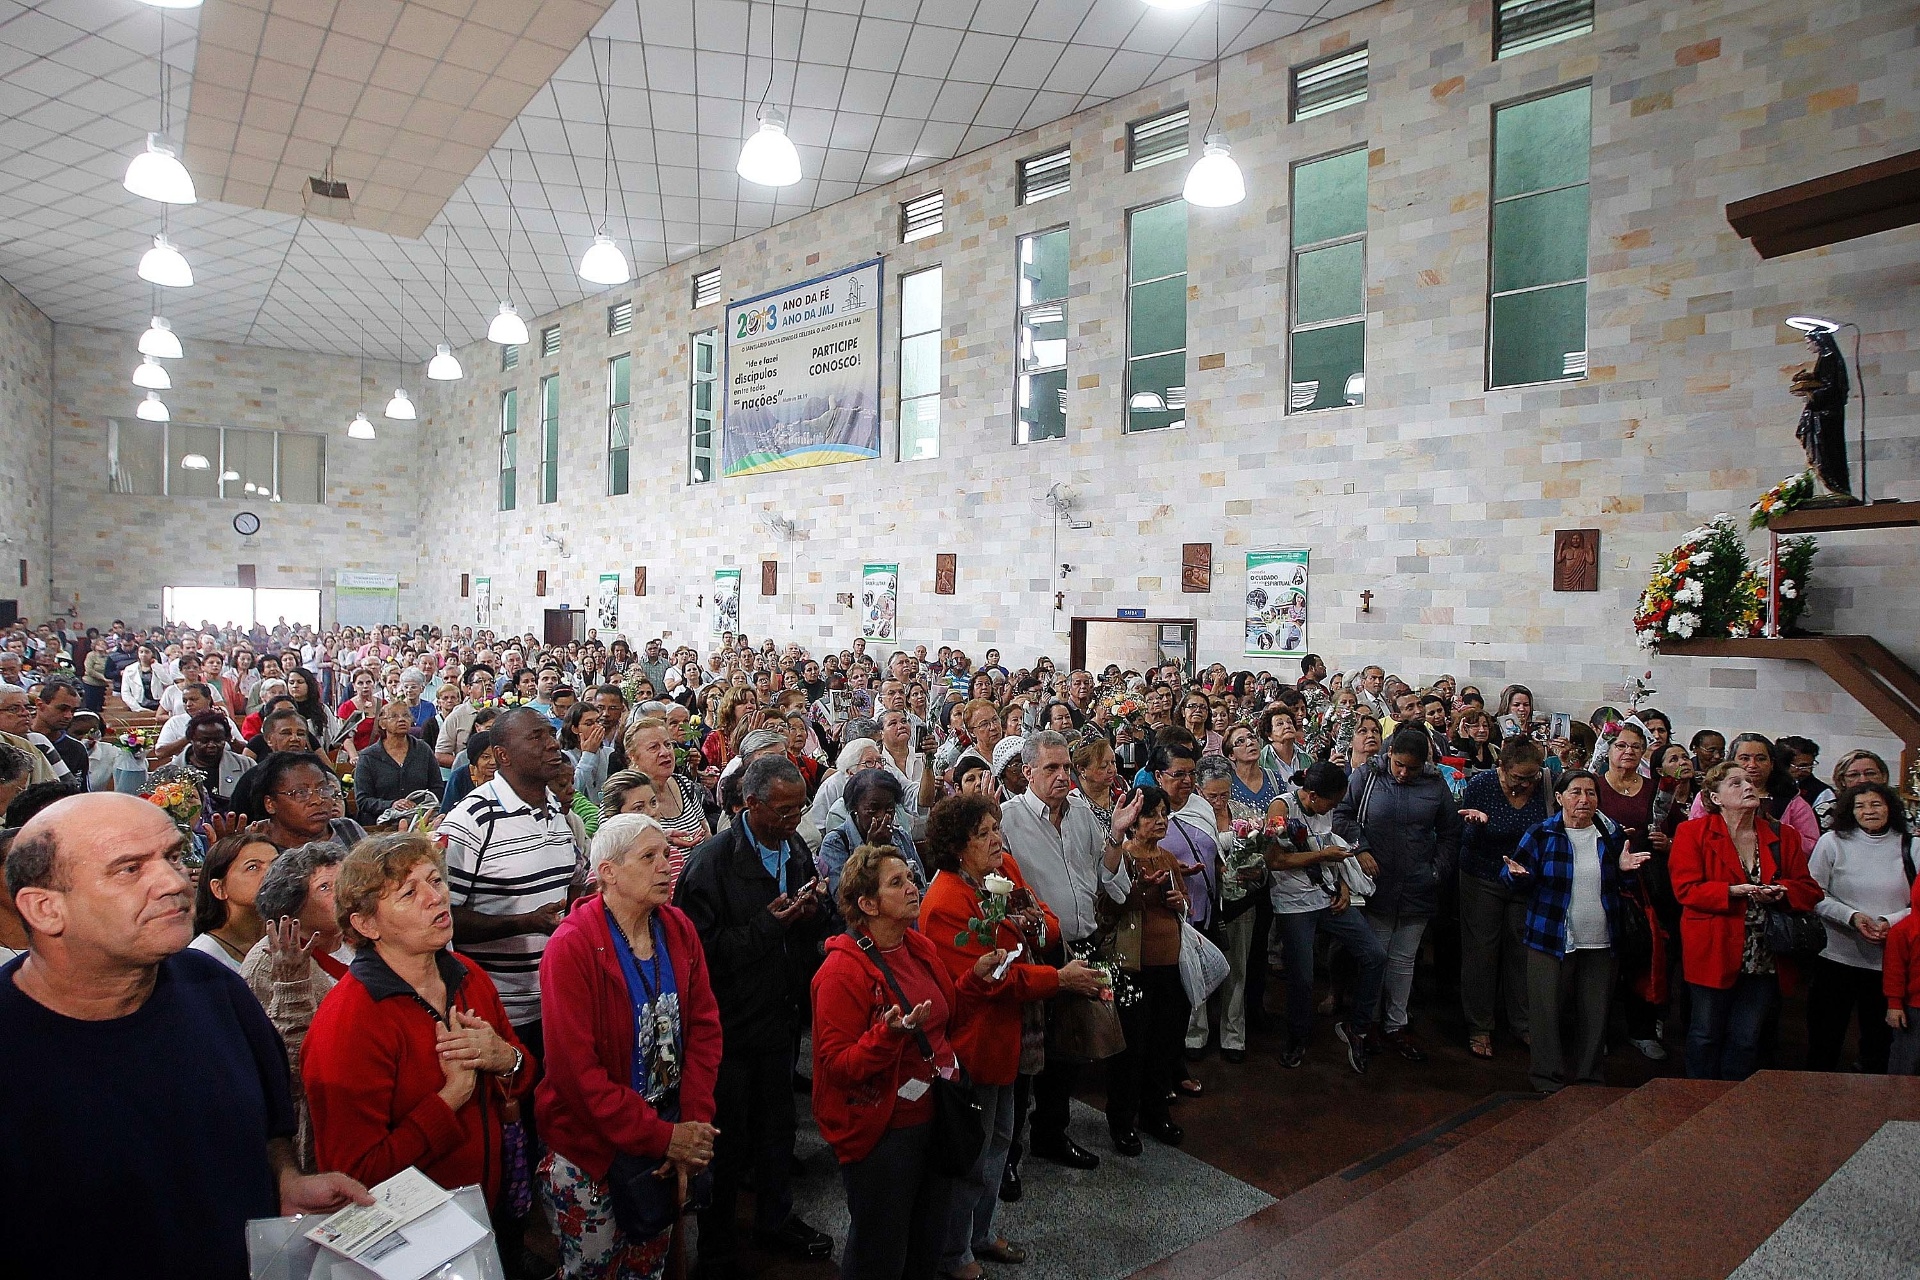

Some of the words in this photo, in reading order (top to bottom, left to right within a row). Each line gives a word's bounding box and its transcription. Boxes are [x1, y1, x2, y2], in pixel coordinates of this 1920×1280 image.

[782, 297, 802, 312] ANO
[805, 293, 817, 305] DA
[820, 286, 830, 300] FÉ
[737, 304, 777, 339] 2013
[782, 312, 802, 327] ANO
[804, 308, 816, 321] DA
[817, 304, 834, 317] JMJ
[820, 324, 831, 333] ANO
[812, 337, 858, 359] PARTICIPE
[763, 354, 779, 365] fazei
[809, 353, 861, 376] CONOSCO!
[733, 387, 749, 396] entre
[750, 383, 766, 393] todas
